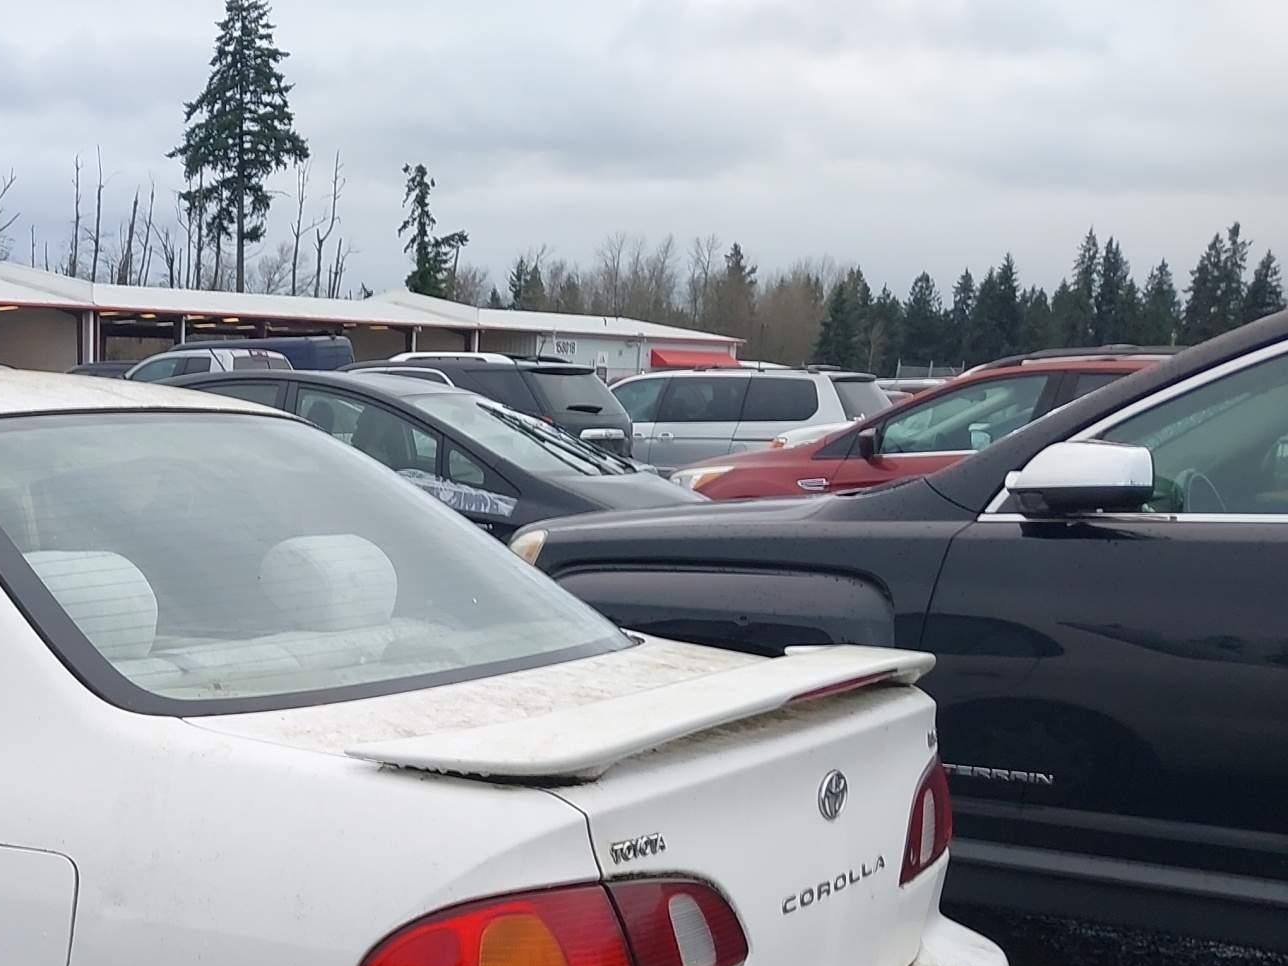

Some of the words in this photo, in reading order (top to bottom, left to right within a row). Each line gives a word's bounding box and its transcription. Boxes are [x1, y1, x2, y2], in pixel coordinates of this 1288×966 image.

[942, 763, 1054, 785] TERRAIN
[610, 832, 667, 865] TOYOTA
[782, 855, 886, 915] COROLLA
